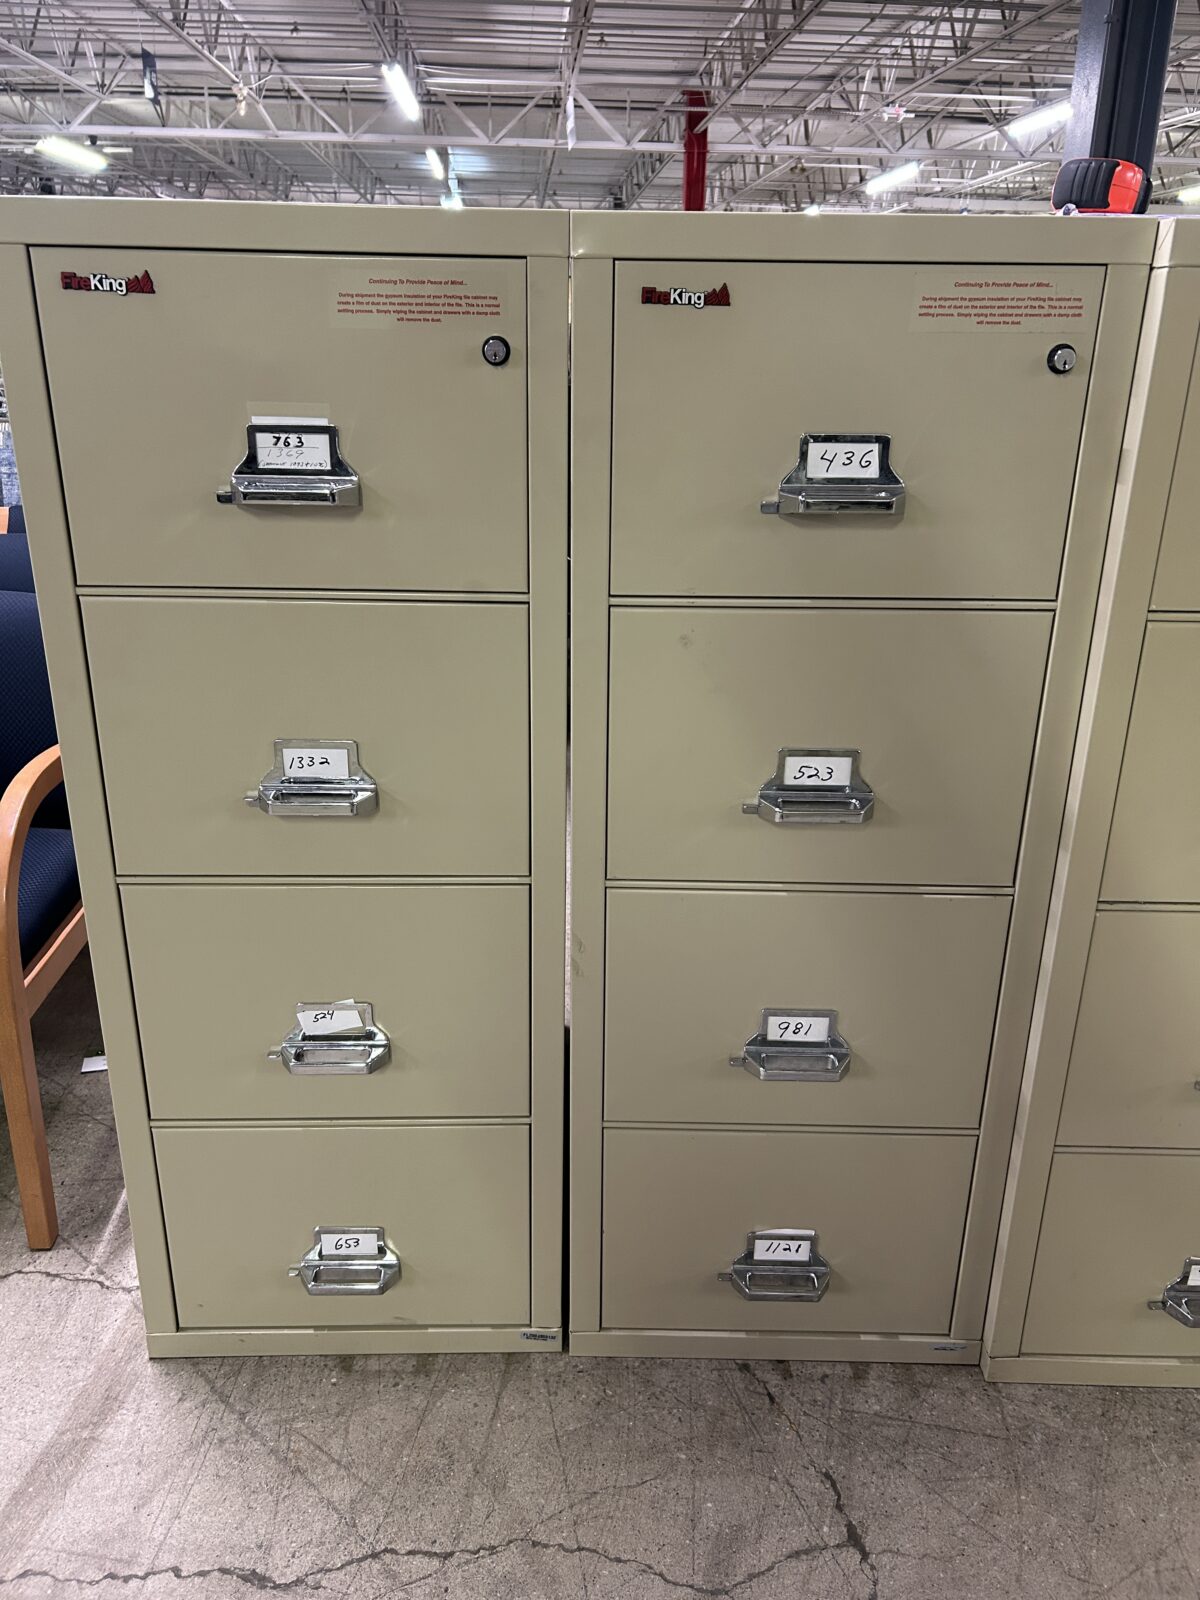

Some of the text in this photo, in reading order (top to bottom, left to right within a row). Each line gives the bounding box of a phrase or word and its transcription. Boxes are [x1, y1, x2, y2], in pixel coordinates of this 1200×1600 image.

[61, 272, 127, 296] FireKing
[641, 287, 706, 309] FireKing
[272, 435, 304, 448] 763
[820, 449, 874, 473] 436
[289, 756, 330, 769] 1332
[793, 765, 834, 781] 523
[312, 1010, 335, 1022] 524
[778, 1021, 812, 1038] 981
[334, 1237, 360, 1250] 653
[765, 1241, 802, 1254] 1121
